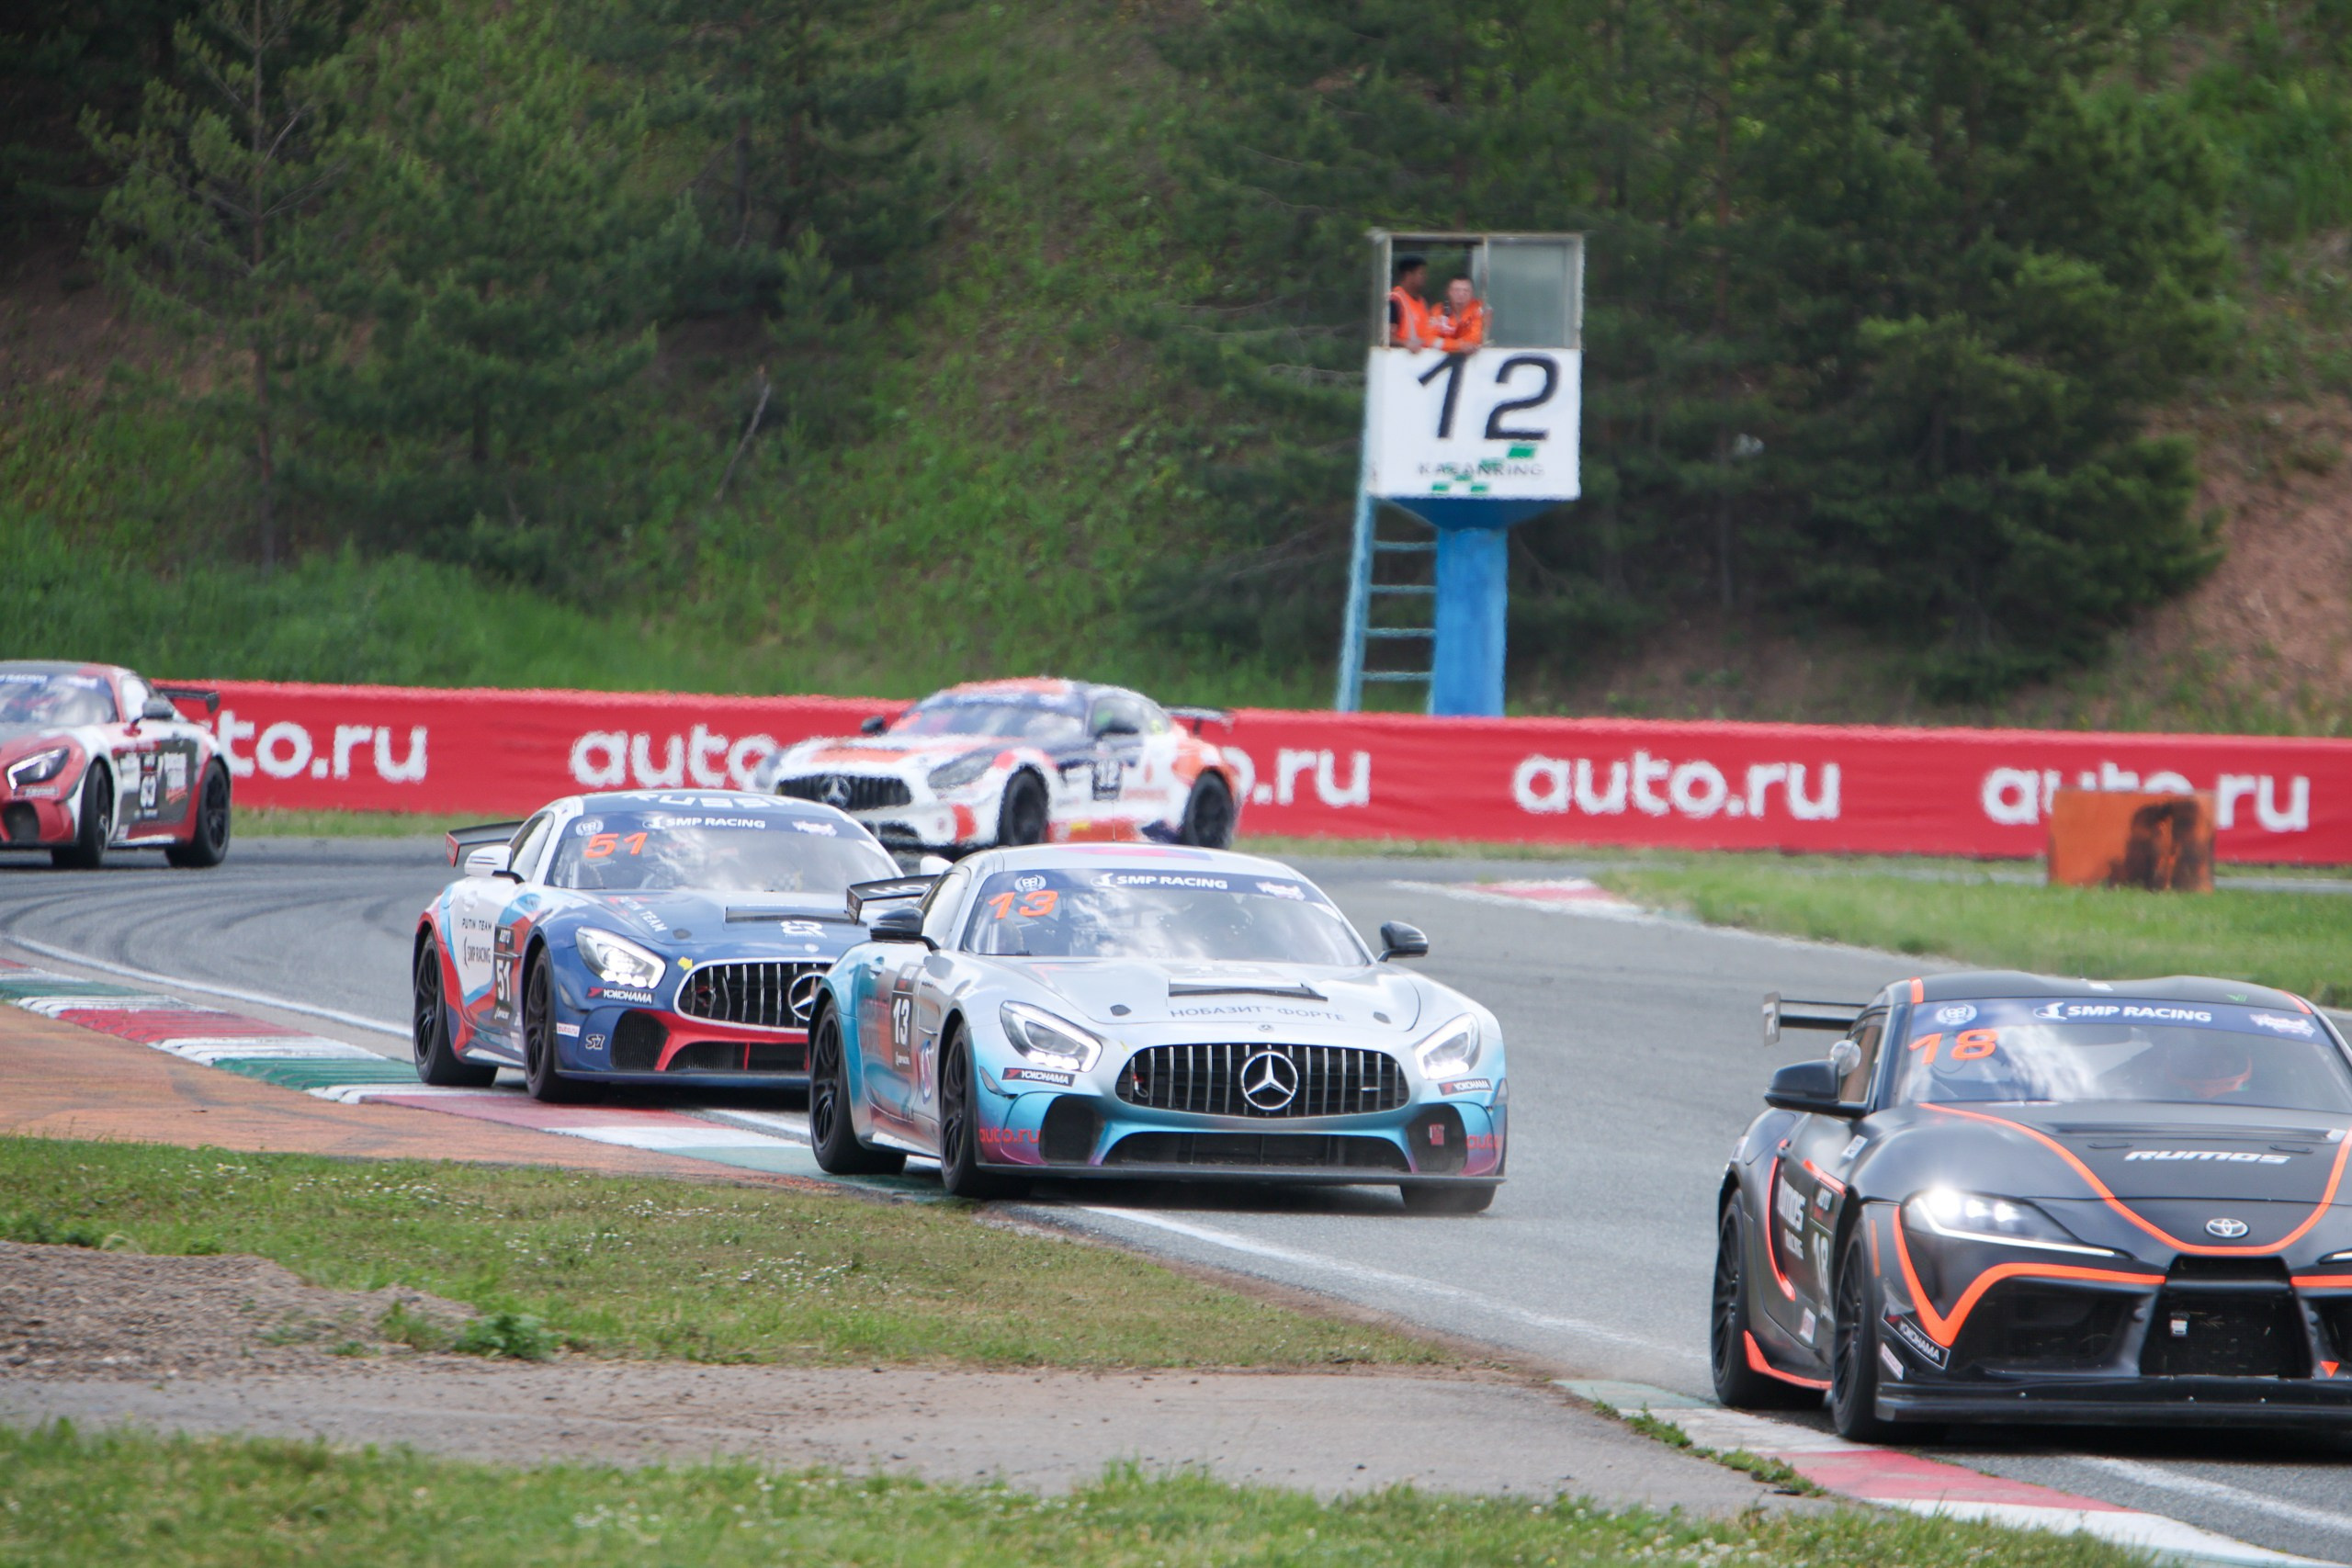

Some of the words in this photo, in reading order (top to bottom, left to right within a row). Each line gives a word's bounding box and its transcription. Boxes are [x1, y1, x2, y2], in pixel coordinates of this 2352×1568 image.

[1418, 352, 1560, 441] 12
[217, 710, 429, 784] to.ru
[568, 723, 779, 794] auto
[1511, 749, 1841, 820] auto.ru
[666, 817, 703, 828] SMP
[705, 818, 766, 829] RACING
[584, 832, 648, 858] 51
[1116, 875, 1157, 886] SMP
[1160, 876, 1228, 890] RACING
[988, 890, 1058, 919] 13
[462, 919, 476, 930] PUTIN
[479, 920, 492, 931] TEAM
[639, 911, 668, 932] TEAM
[496, 959, 512, 1002] 51
[604, 989, 652, 1004] YOKOHAMA
[893, 998, 910, 1044] 13
[1278, 1008, 1347, 1021] ФОРТЕ
[2067, 1005, 2120, 1016] SMP
[2123, 1007, 2212, 1022] RACING
[1908, 1028, 1998, 1065] 18
[1021, 1070, 1069, 1084] YOKOHAMA
[1453, 1079, 1490, 1091] YOKOHAMA
[978, 1126, 1040, 1144] auto.ru
[2123, 1150, 2291, 1165] RUMOS
[1813, 1231, 1829, 1295] 18
